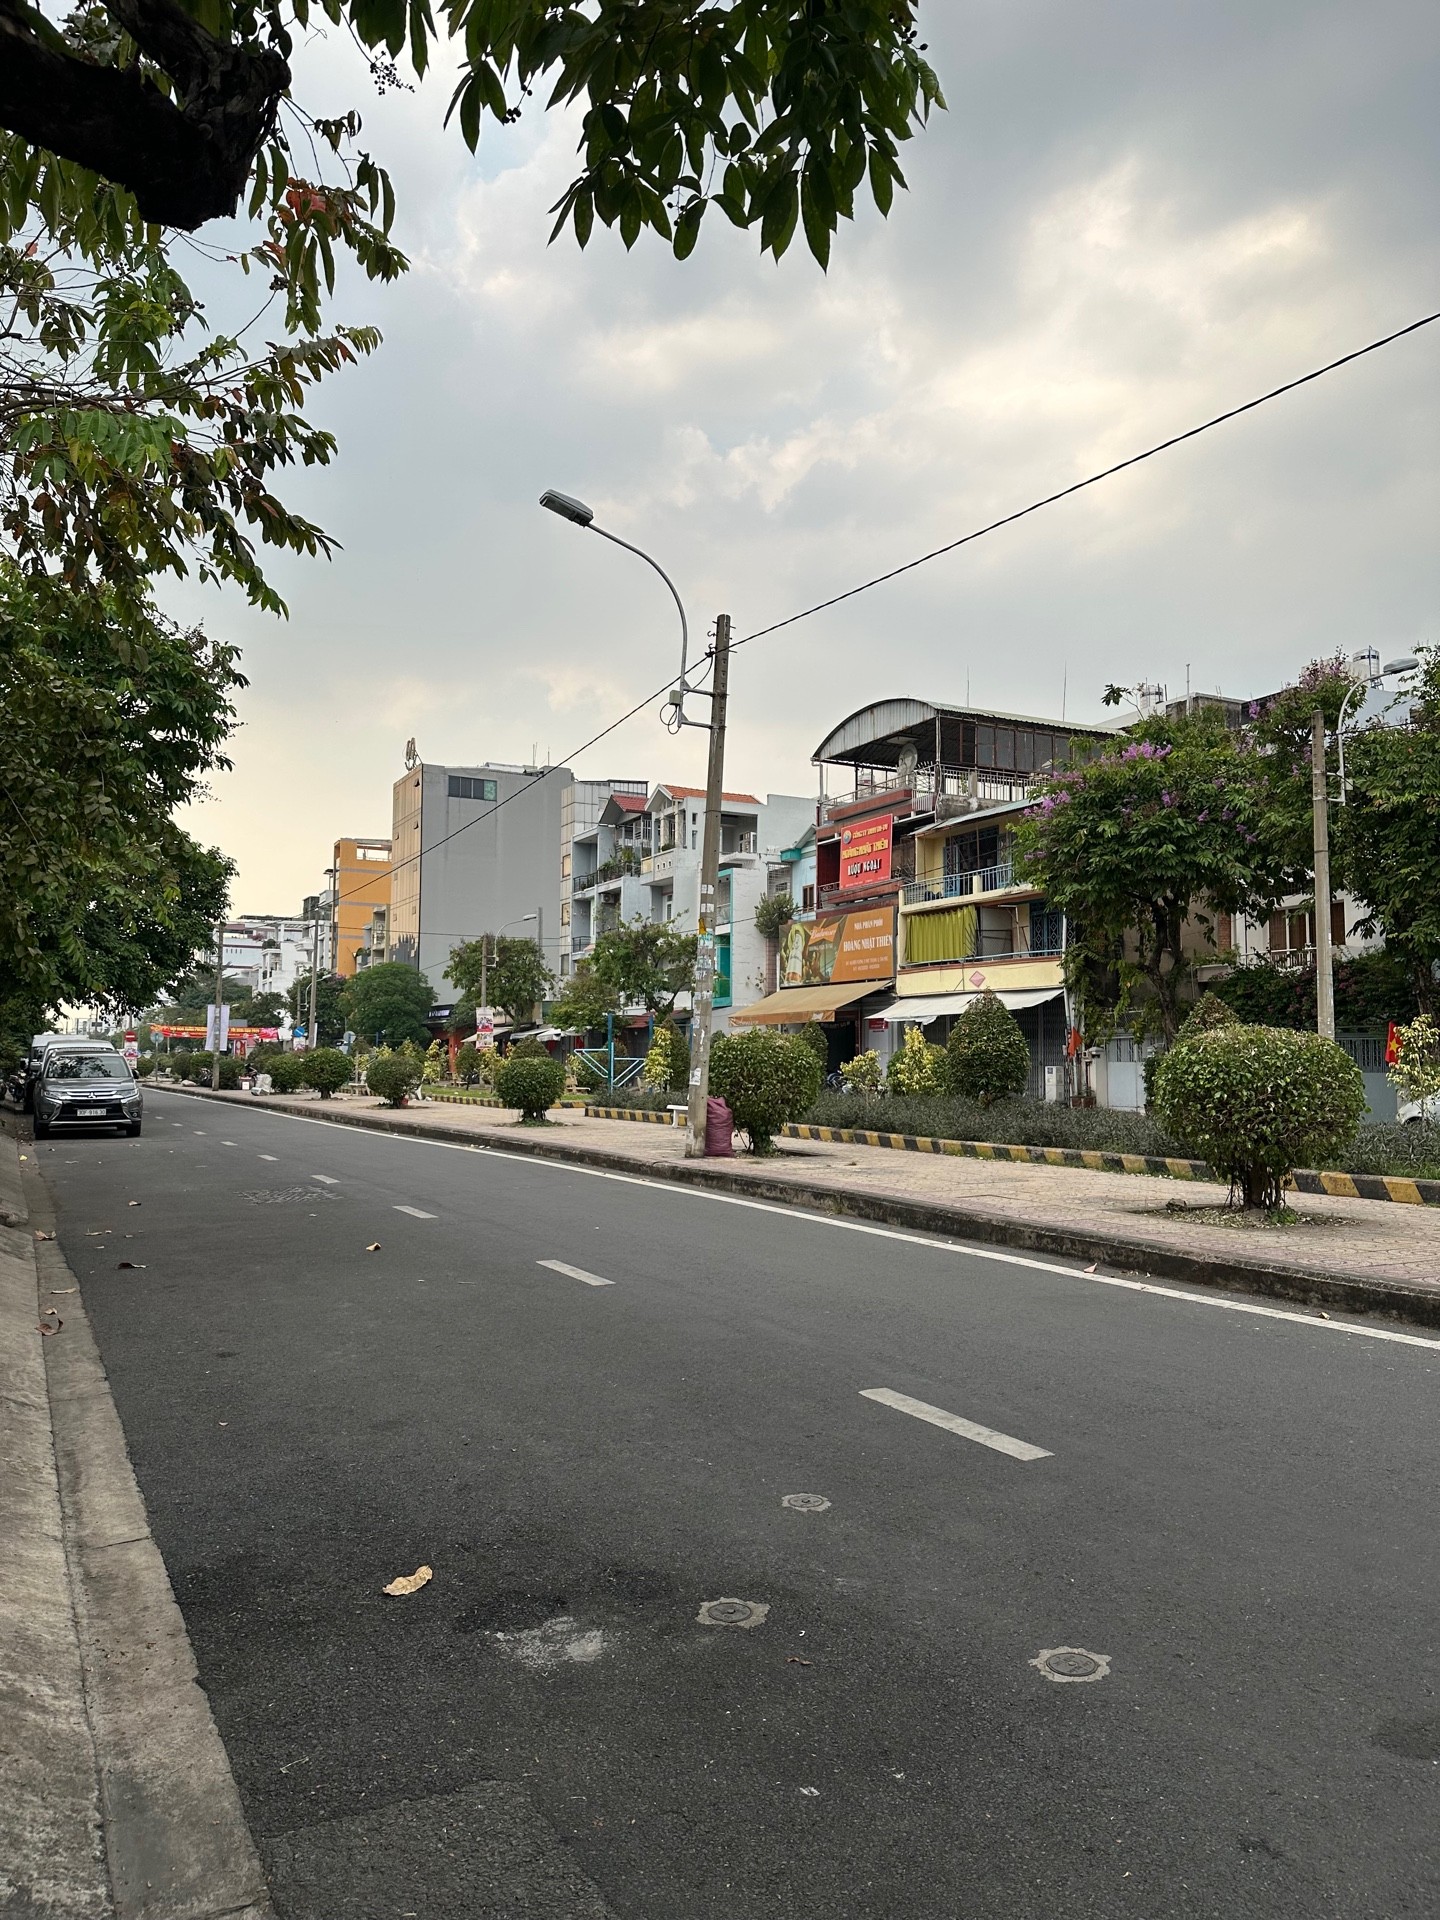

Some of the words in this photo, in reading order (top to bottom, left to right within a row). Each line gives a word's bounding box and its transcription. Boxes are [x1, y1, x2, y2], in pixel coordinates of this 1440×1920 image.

[843, 938, 861, 952] HOÀNG
[861, 936, 875, 951] NHẬT
[876, 934, 893, 948] THIÊN
